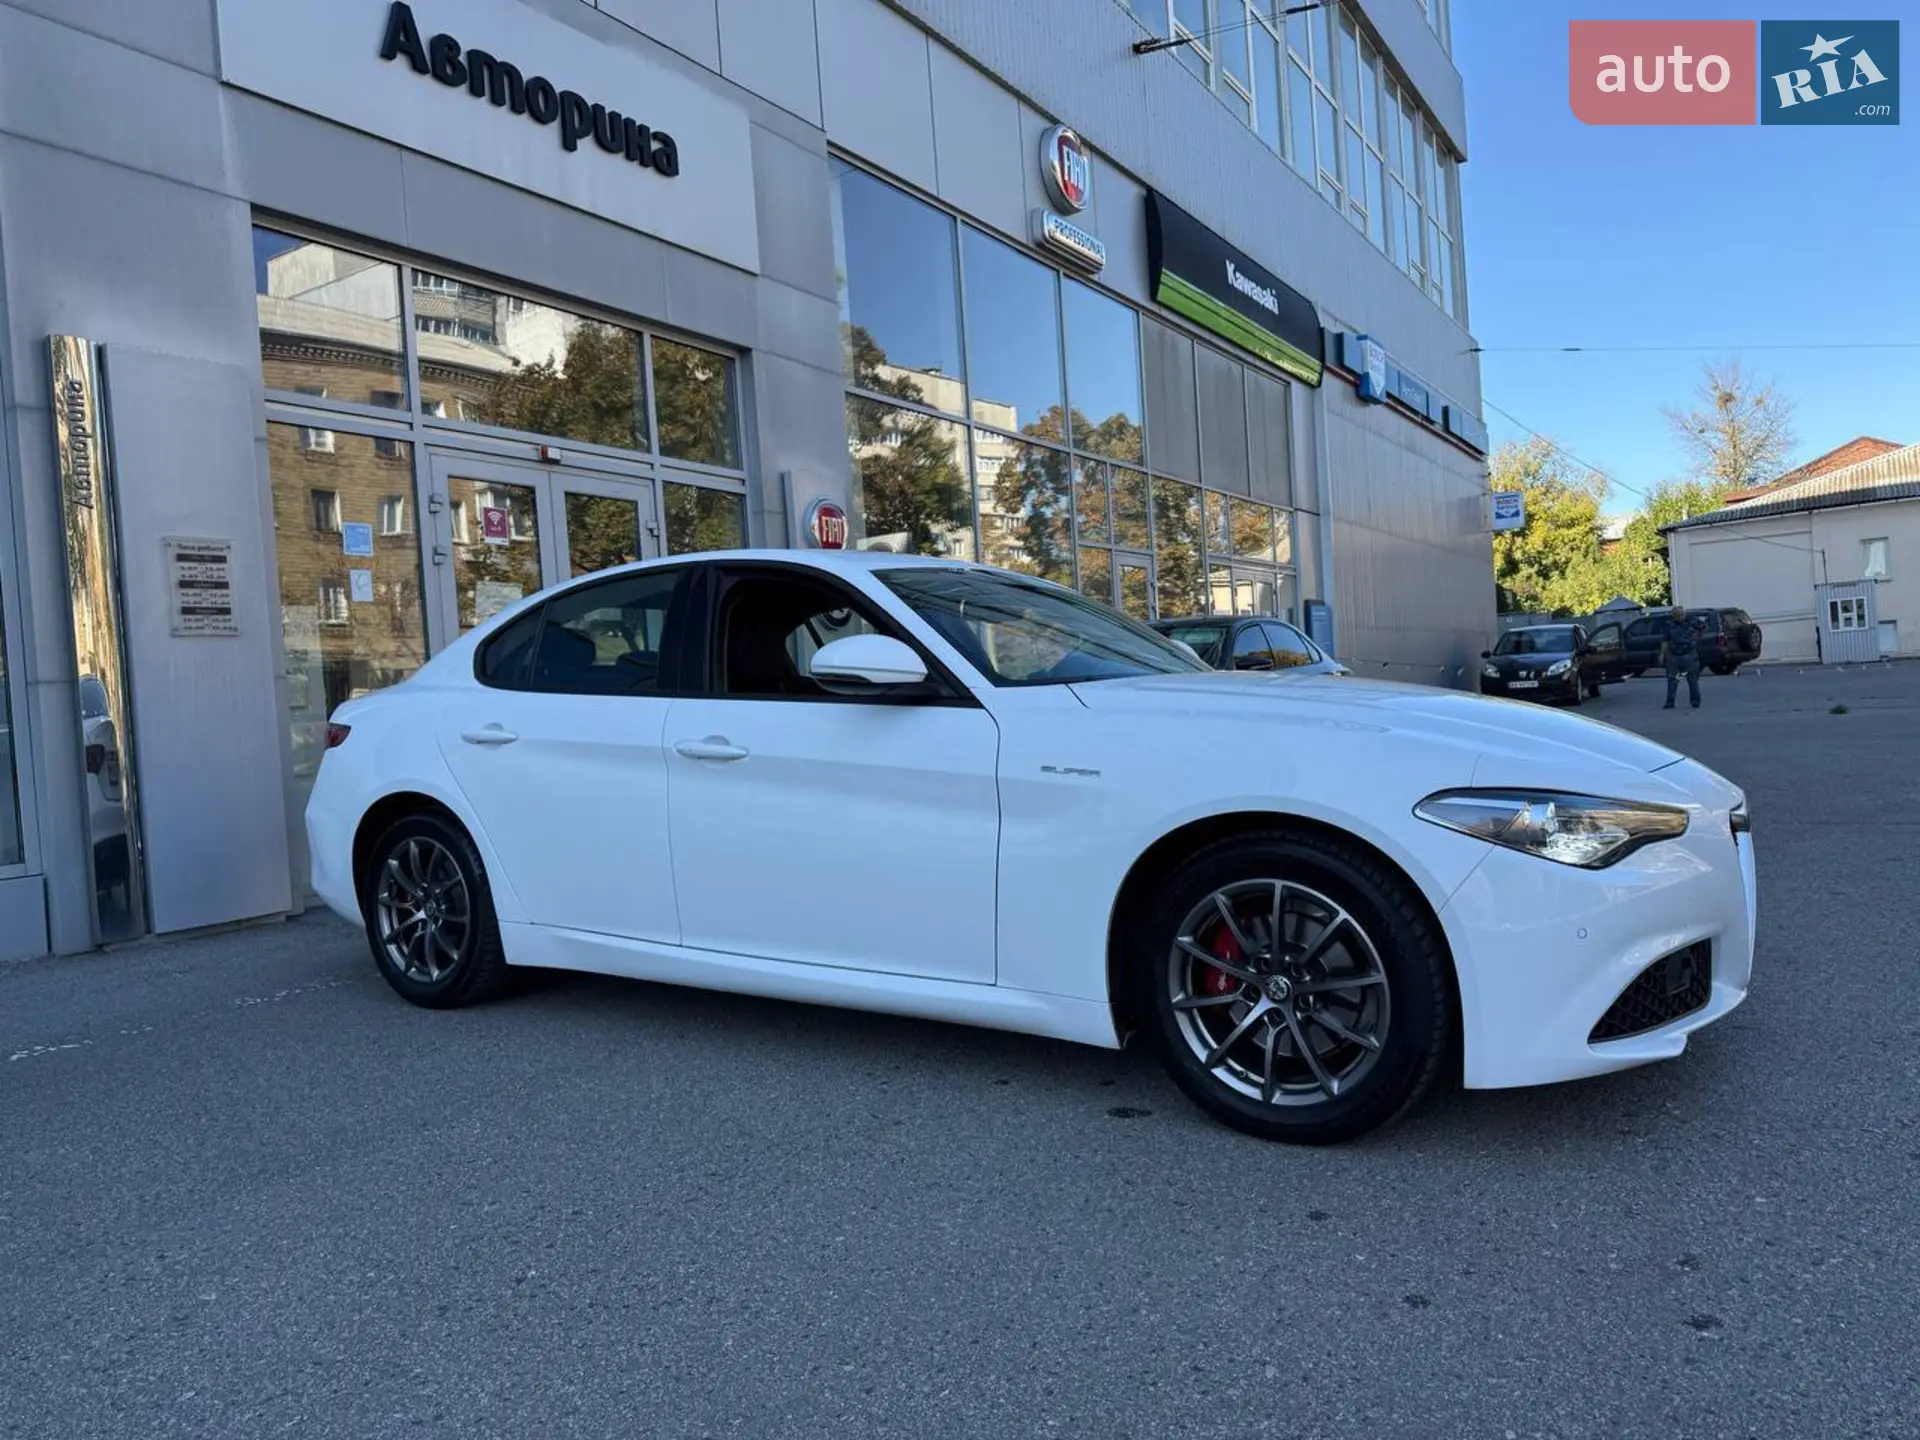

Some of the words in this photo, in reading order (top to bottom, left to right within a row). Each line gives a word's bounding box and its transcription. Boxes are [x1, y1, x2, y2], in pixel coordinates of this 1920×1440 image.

[379, 1, 680, 178] Авторина
[1062, 143, 1088, 192] FIAT
[1054, 218, 1105, 260] PROFESSIONAL
[1225, 259, 1279, 316] Kawasaki
[67, 380, 94, 510] Авторина
[821, 515, 845, 544] FIAT
